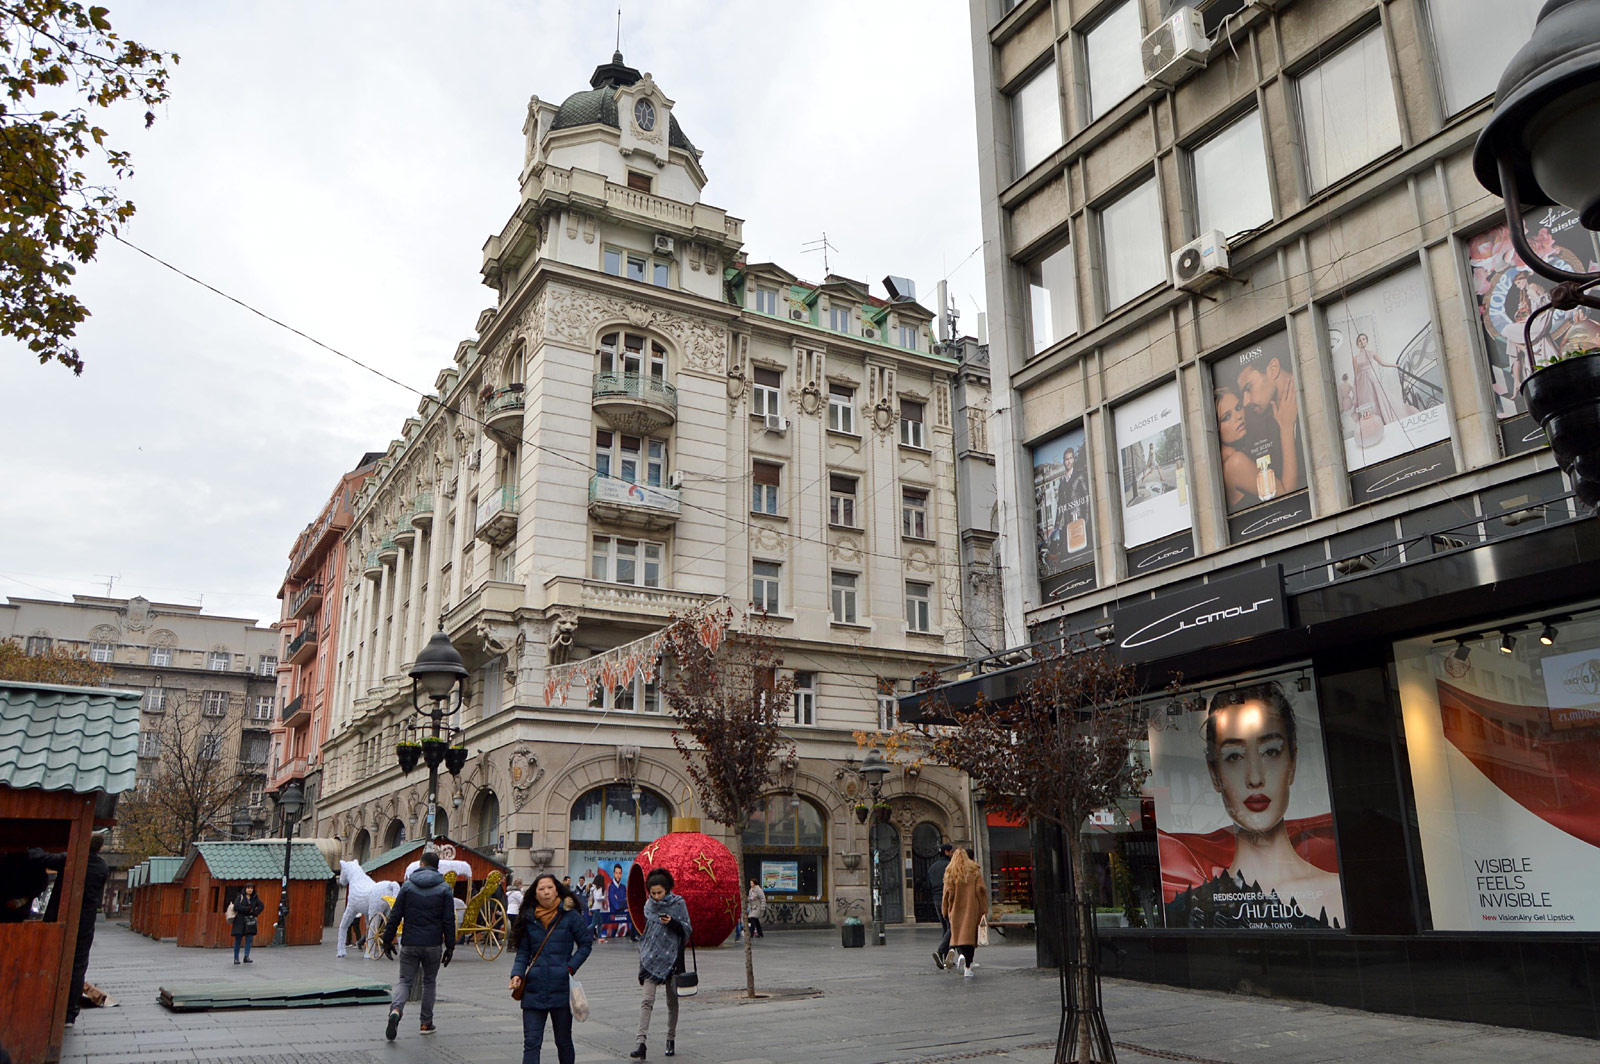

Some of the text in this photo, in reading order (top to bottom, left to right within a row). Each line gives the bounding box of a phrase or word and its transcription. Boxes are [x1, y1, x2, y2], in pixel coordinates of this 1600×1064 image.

[1239, 346, 1262, 363] BOSS
[1130, 414, 1159, 432] LACOSTE
[1401, 408, 1439, 428] LALIQUE
[1474, 858, 1533, 874] VISIBLE
[1476, 875, 1526, 891] FEELS
[1212, 892, 1257, 902] REDISCOVER
[1479, 892, 1552, 908] INVISIBLE
[1232, 902, 1306, 920] SHISEIDO
[1547, 914, 1575, 922] Lipstick
